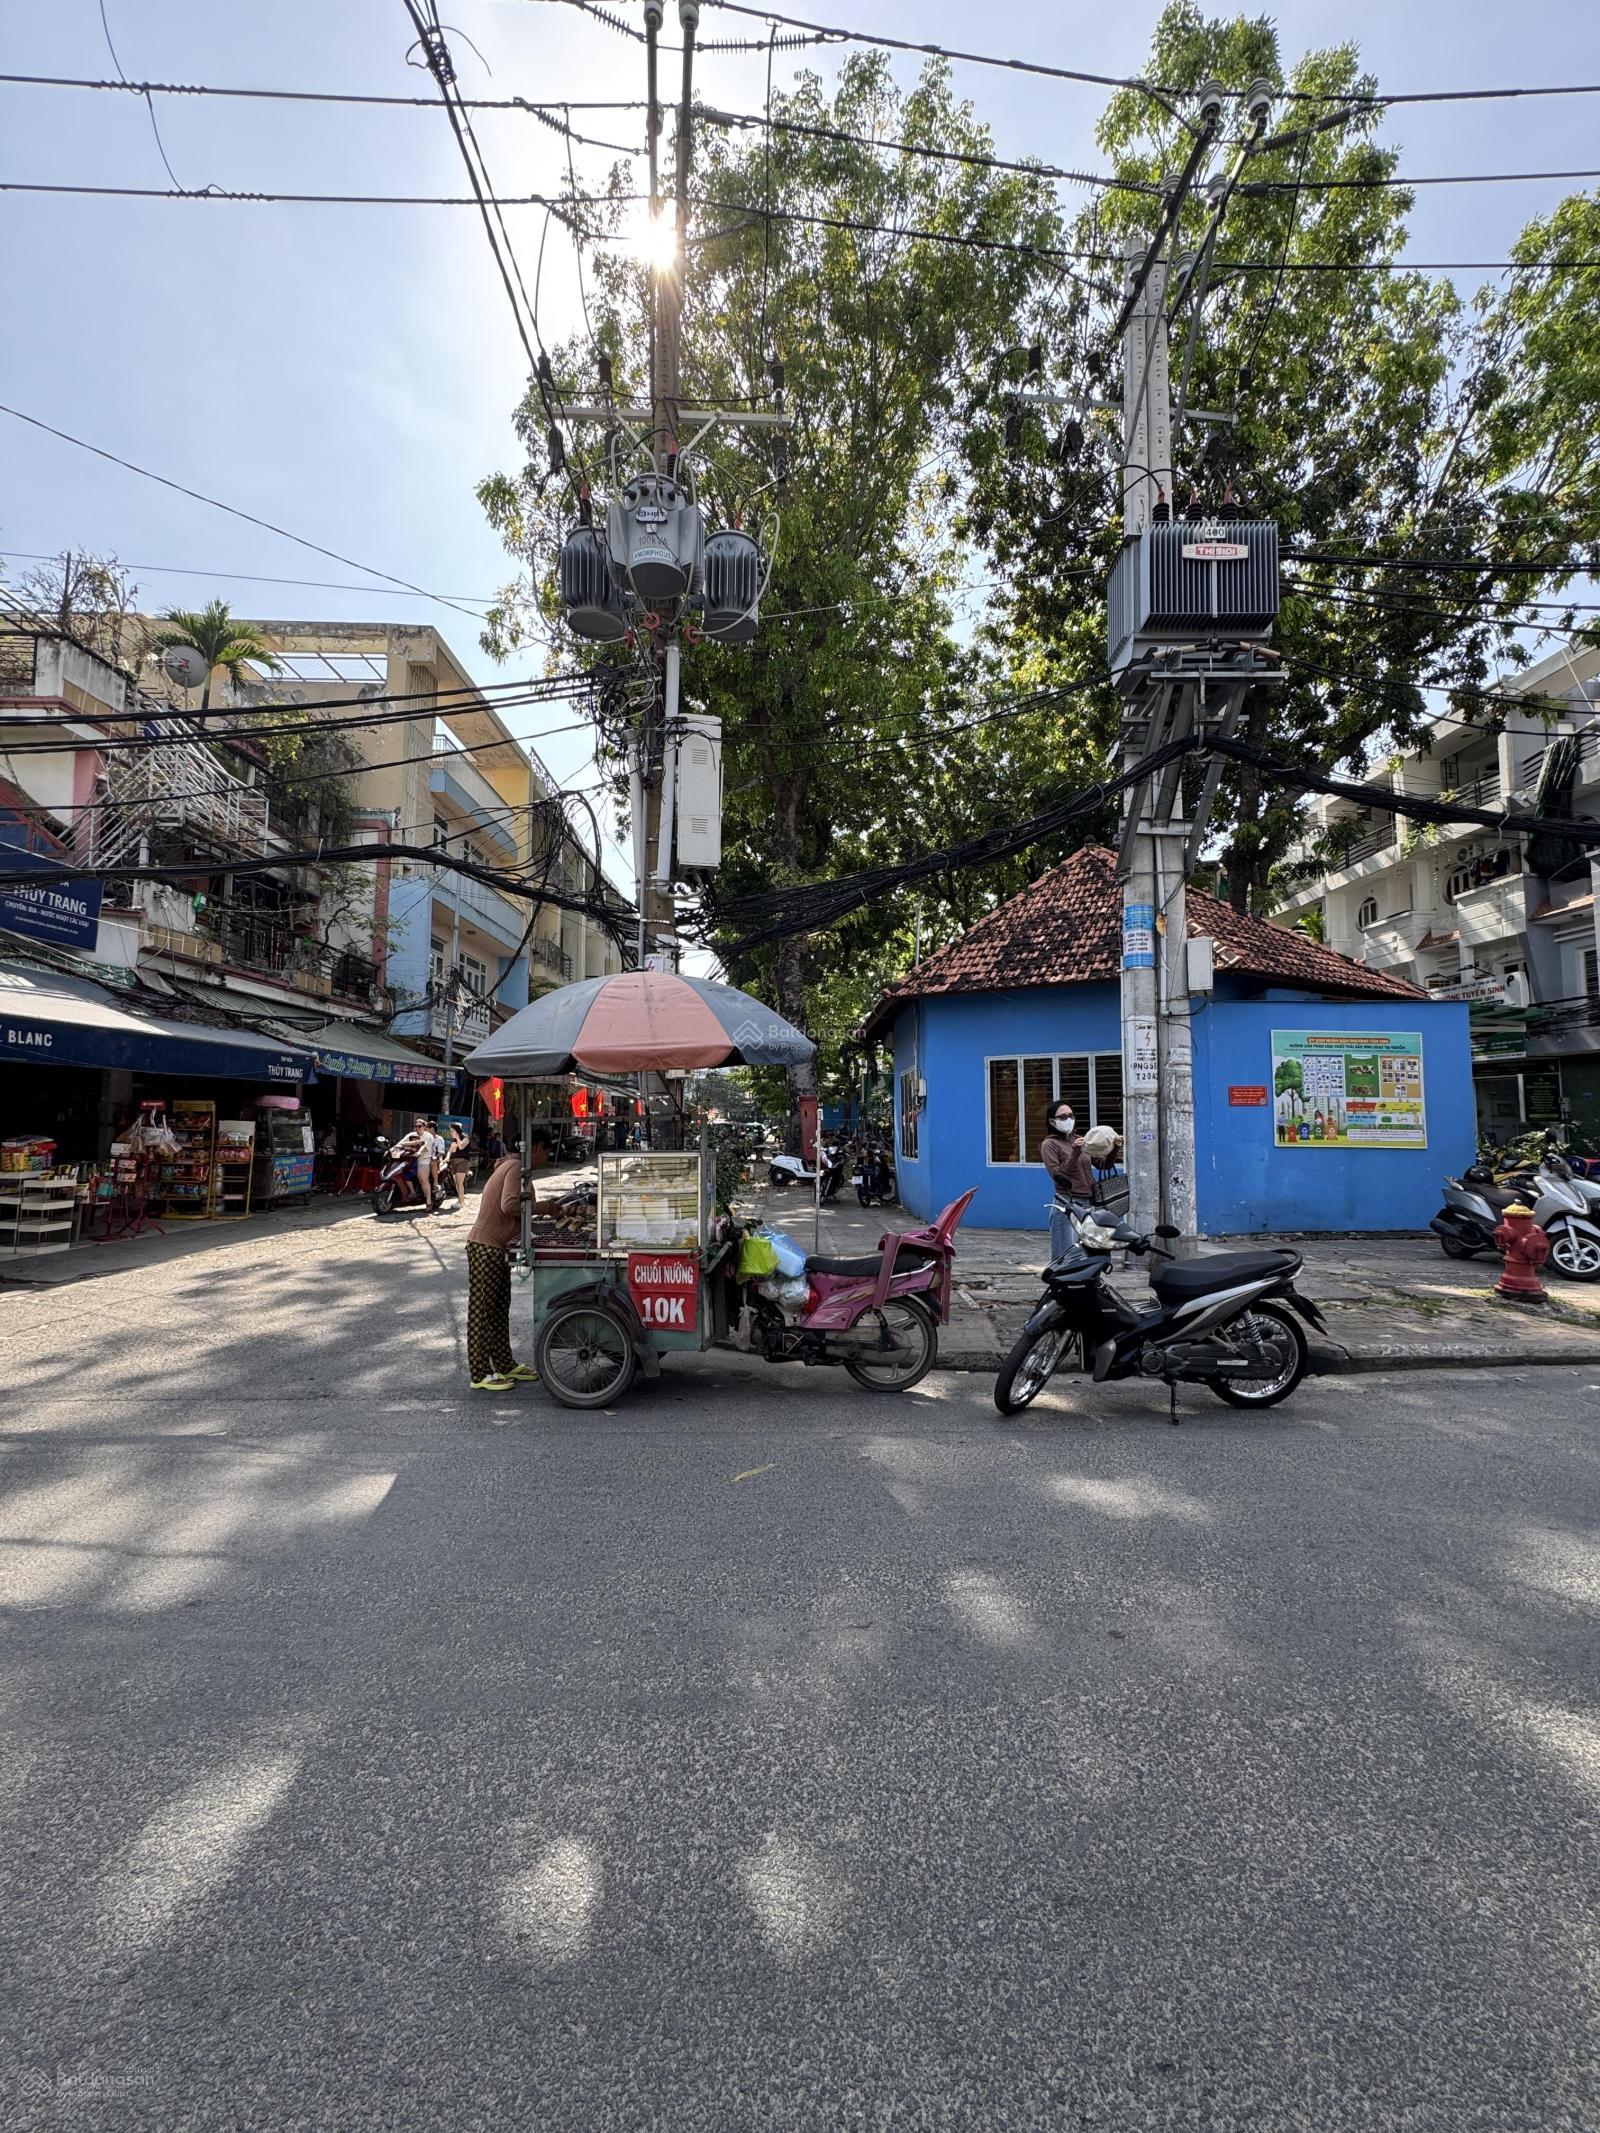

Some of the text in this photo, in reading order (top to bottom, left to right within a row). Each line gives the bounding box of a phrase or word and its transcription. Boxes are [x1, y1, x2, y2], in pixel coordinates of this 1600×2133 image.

[634, 549, 672, 559] AMORPHOUS
[49, 891, 87, 915] TRANG
[1487, 985, 1505, 995] SINH
[8, 1029, 53, 1047] BLANC
[284, 1066, 304, 1078] TRANG
[634, 1258, 694, 1285] CHUỐI NƯỚNG
[642, 1297, 685, 1324] 10K
